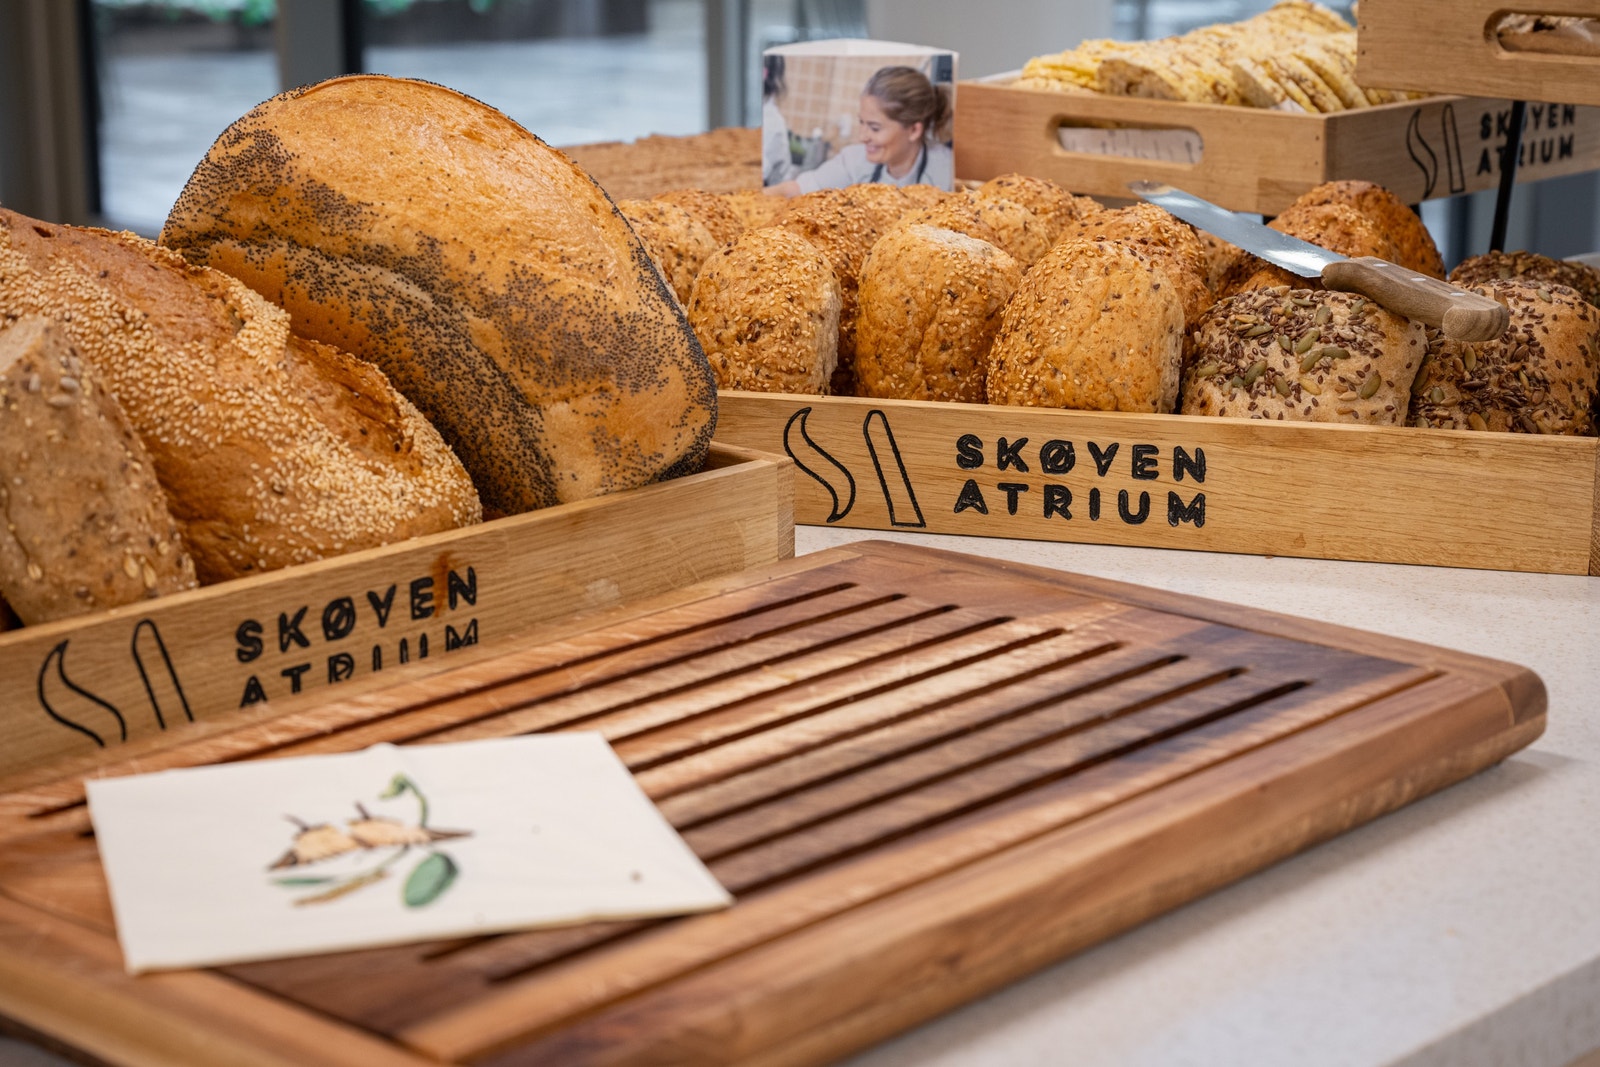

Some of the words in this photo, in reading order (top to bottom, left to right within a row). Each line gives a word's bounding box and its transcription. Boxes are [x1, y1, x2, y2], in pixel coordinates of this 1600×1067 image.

[1480, 104, 1575, 140] SKYEN
[956, 433, 1207, 483] SKØYEN
[953, 478, 1206, 528] ATRIUM
[235, 566, 478, 663] SKØYEN
